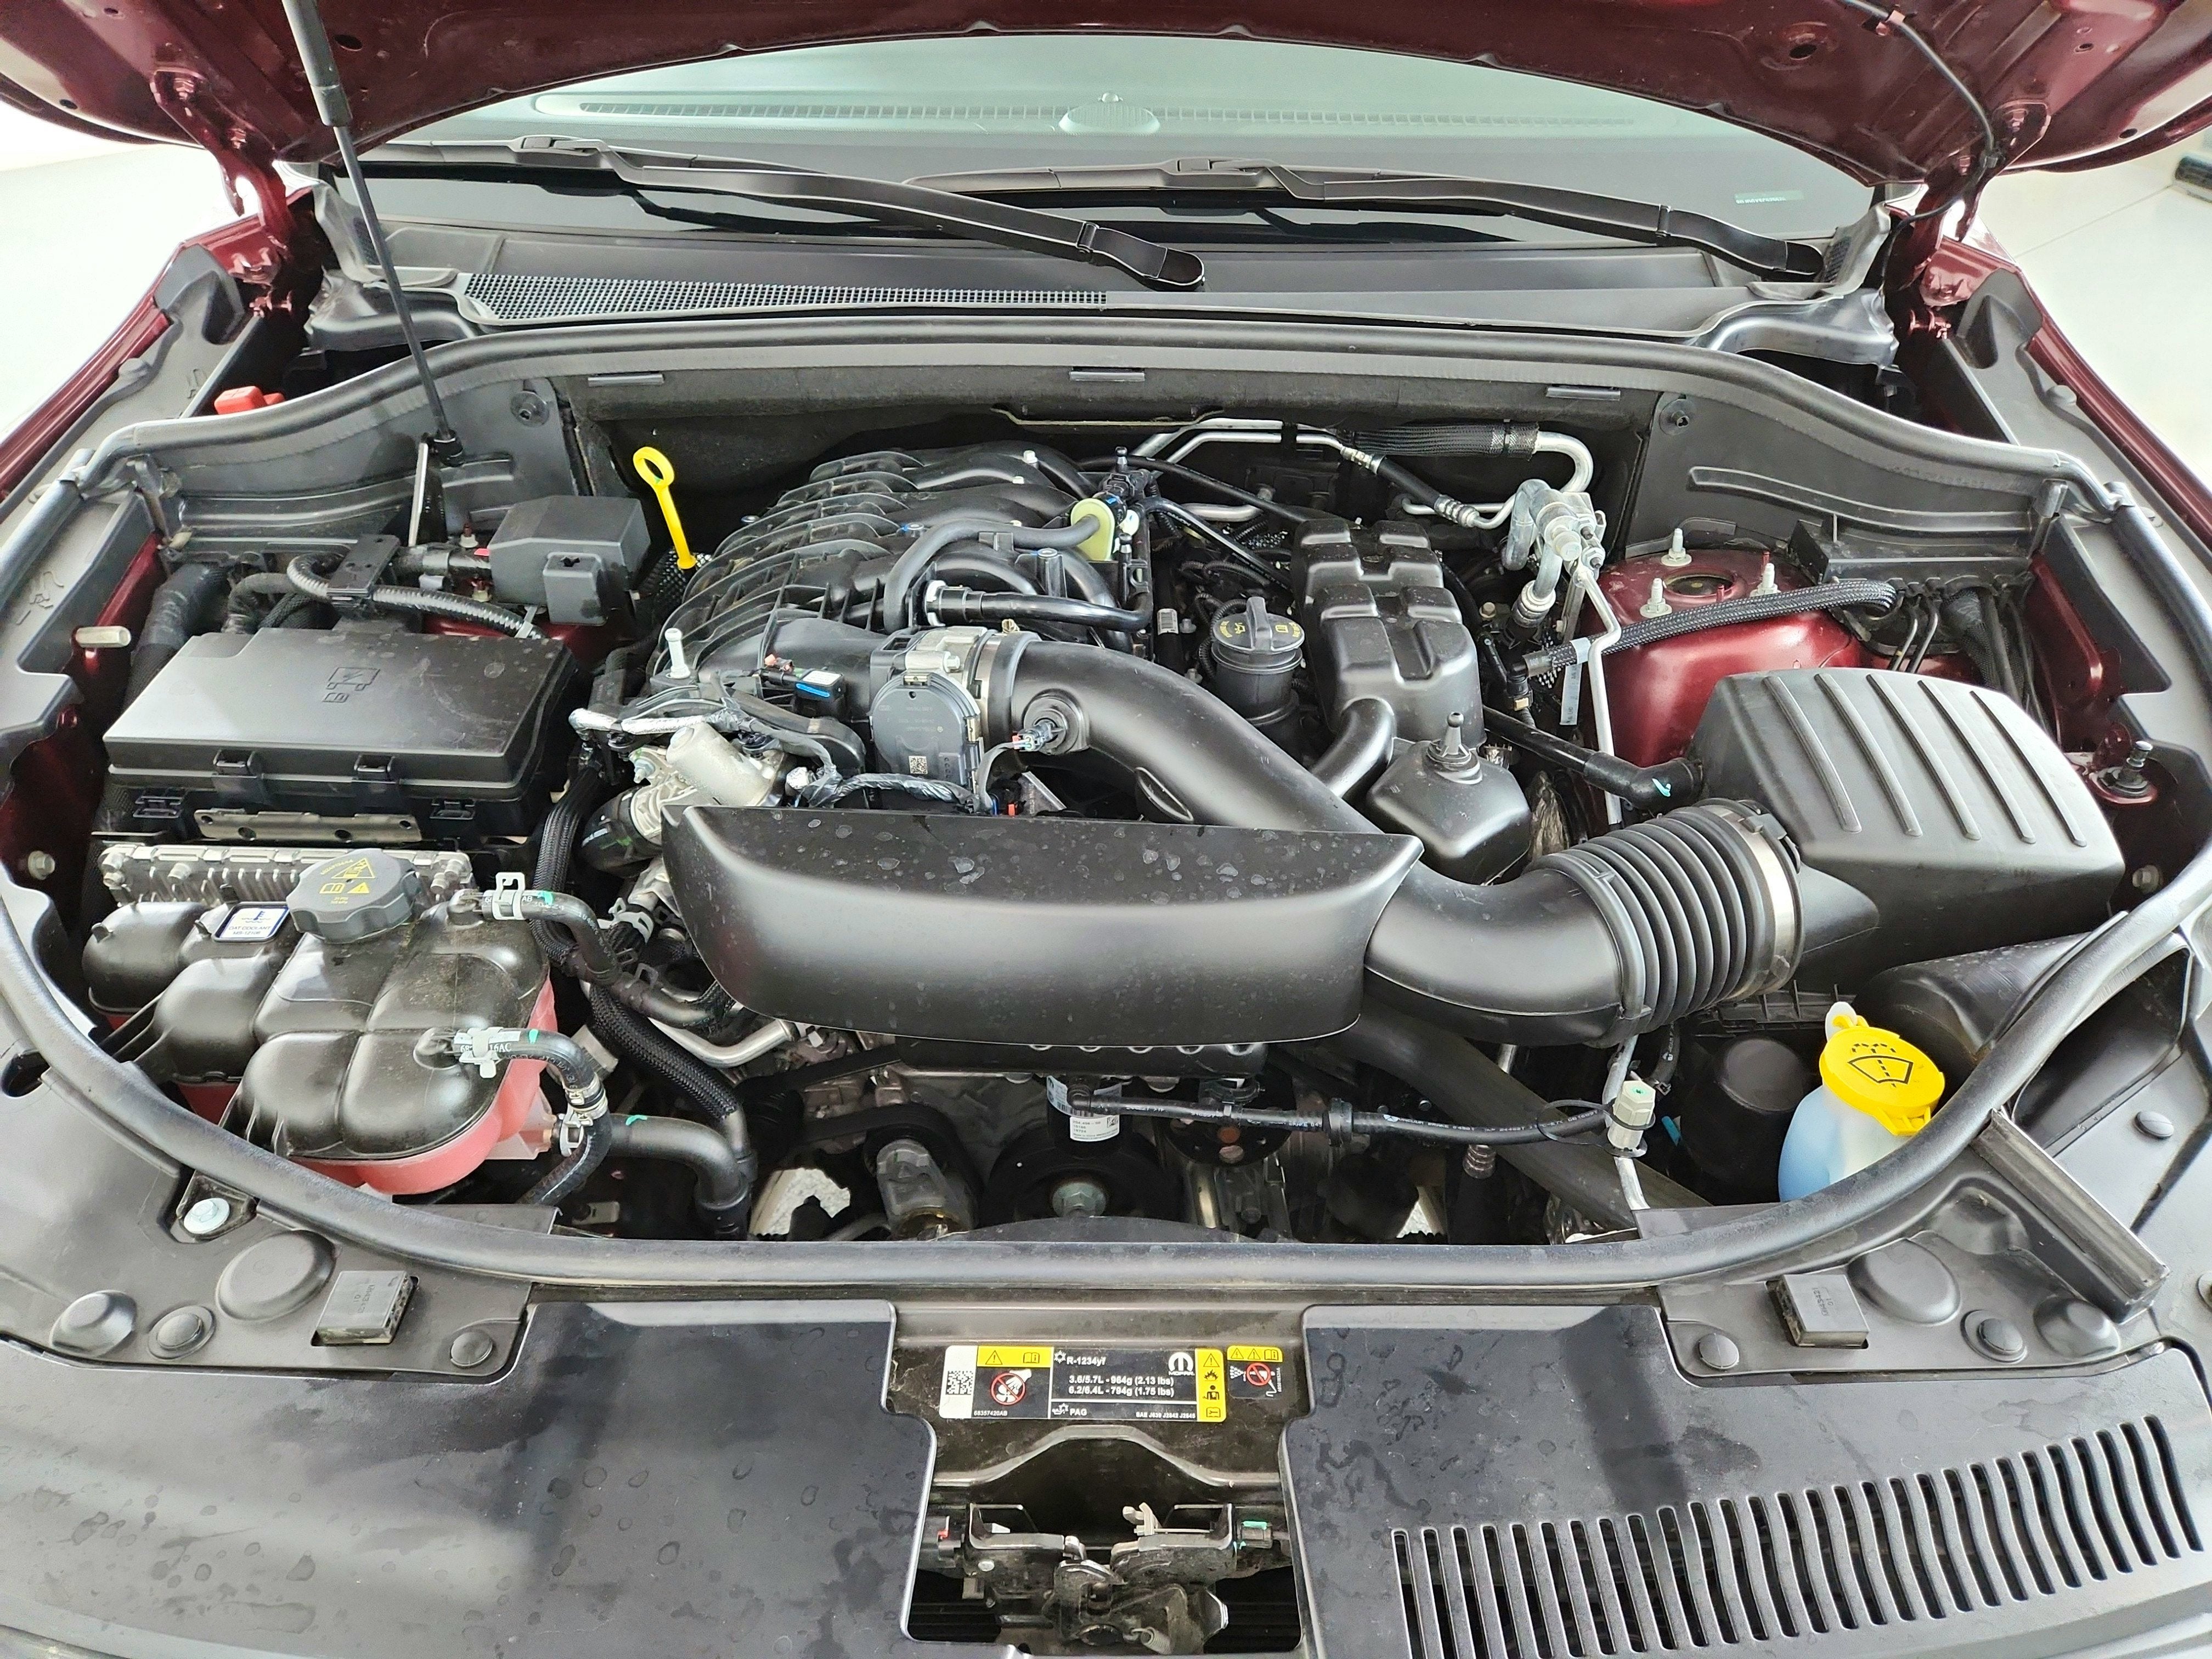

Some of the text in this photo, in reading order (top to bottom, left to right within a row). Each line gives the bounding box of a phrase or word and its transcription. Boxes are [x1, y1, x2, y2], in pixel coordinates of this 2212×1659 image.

[1066, 1356, 1107, 1367] R-1234yf
[1069, 1375, 1104, 1384] 3.6/5.7L
[1111, 1375, 1132, 1386] 964g
[1135, 1376, 1155, 1386] (2.13
[1157, 1376, 1174, 1387] lbs)
[1068, 1386, 1104, 1395] 6.2/6.4L
[1110, 1386, 1132, 1397] 794g
[1135, 1387, 1156, 1397] (1.75
[1158, 1387, 1175, 1398] lbs)
[1070, 1408, 1087, 1417] PAG
